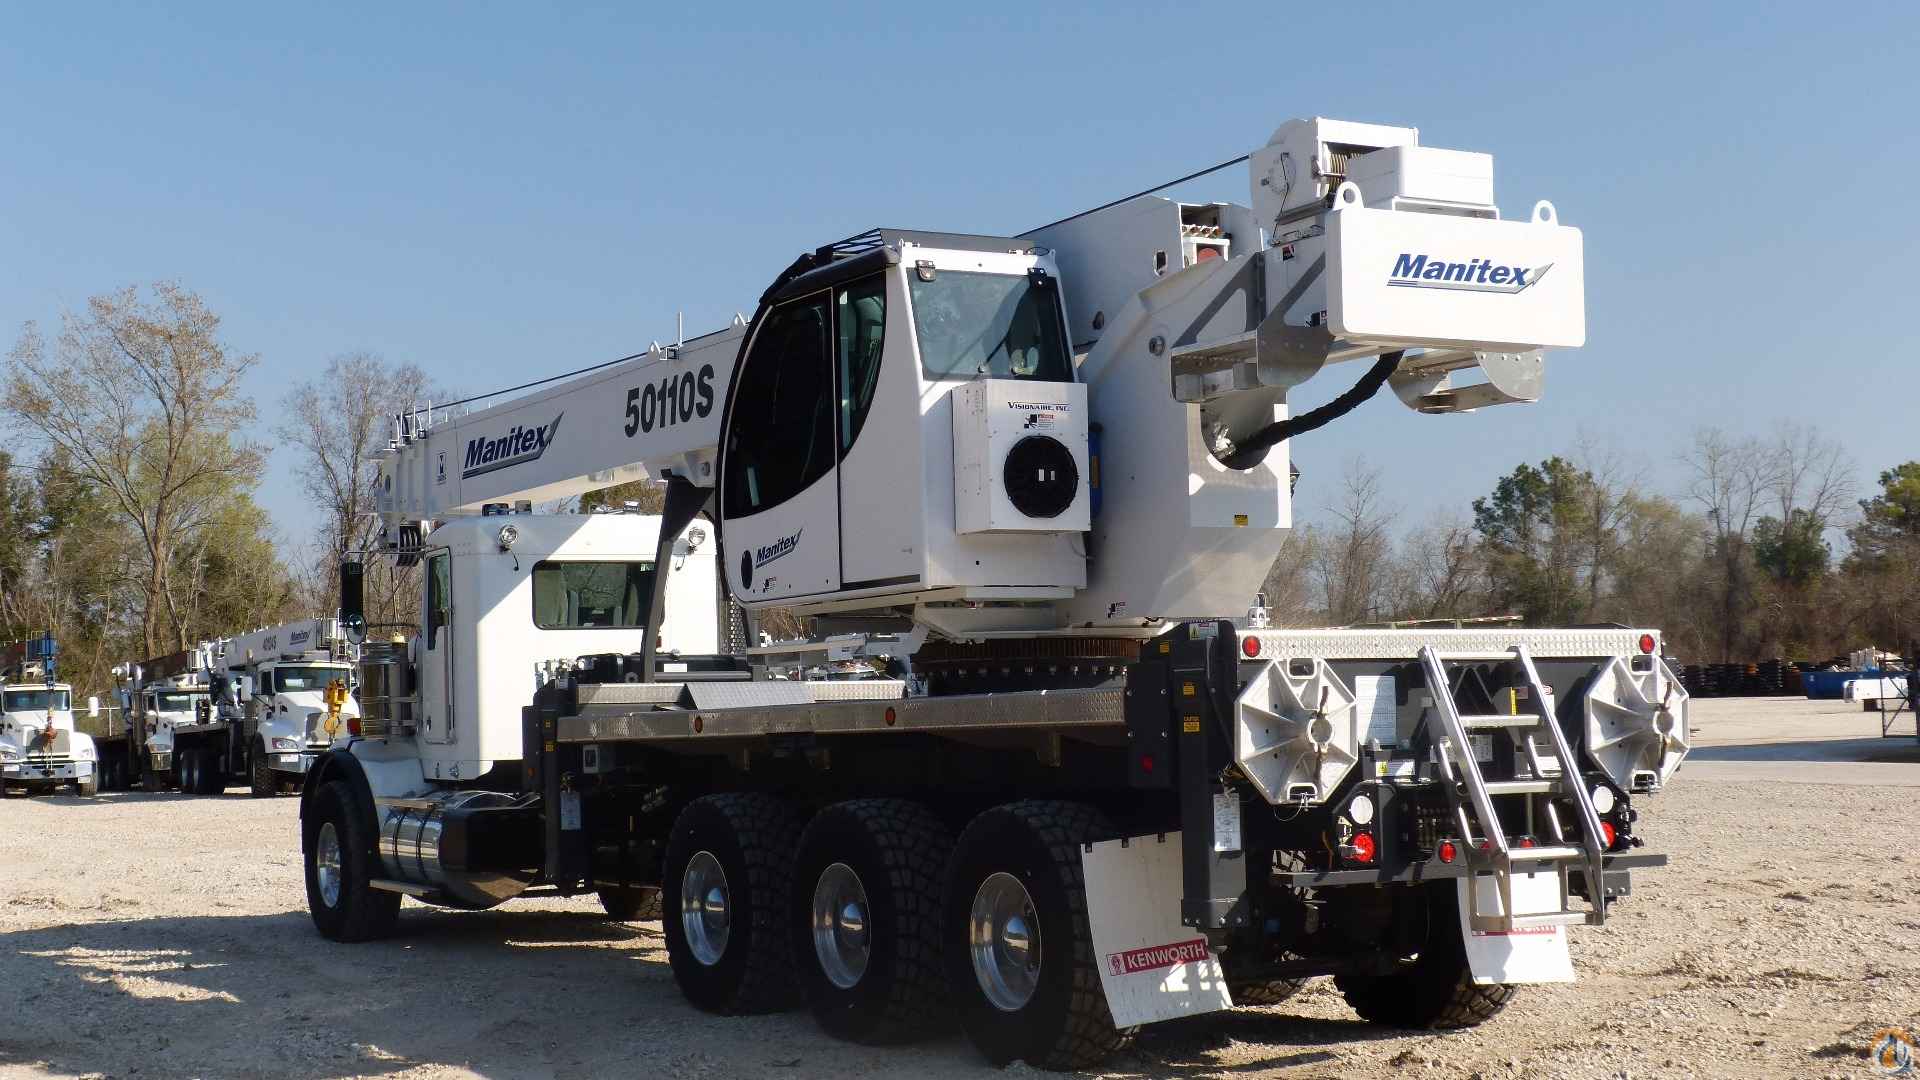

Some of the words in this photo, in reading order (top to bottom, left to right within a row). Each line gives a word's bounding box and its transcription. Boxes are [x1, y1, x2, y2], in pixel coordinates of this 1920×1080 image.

[1391, 254, 1530, 286] Manitex
[625, 364, 714, 438] 50110S
[465, 424, 549, 469] Manitex
[756, 536, 798, 563] Manitex
[1127, 943, 1205, 969] KENWORTH
